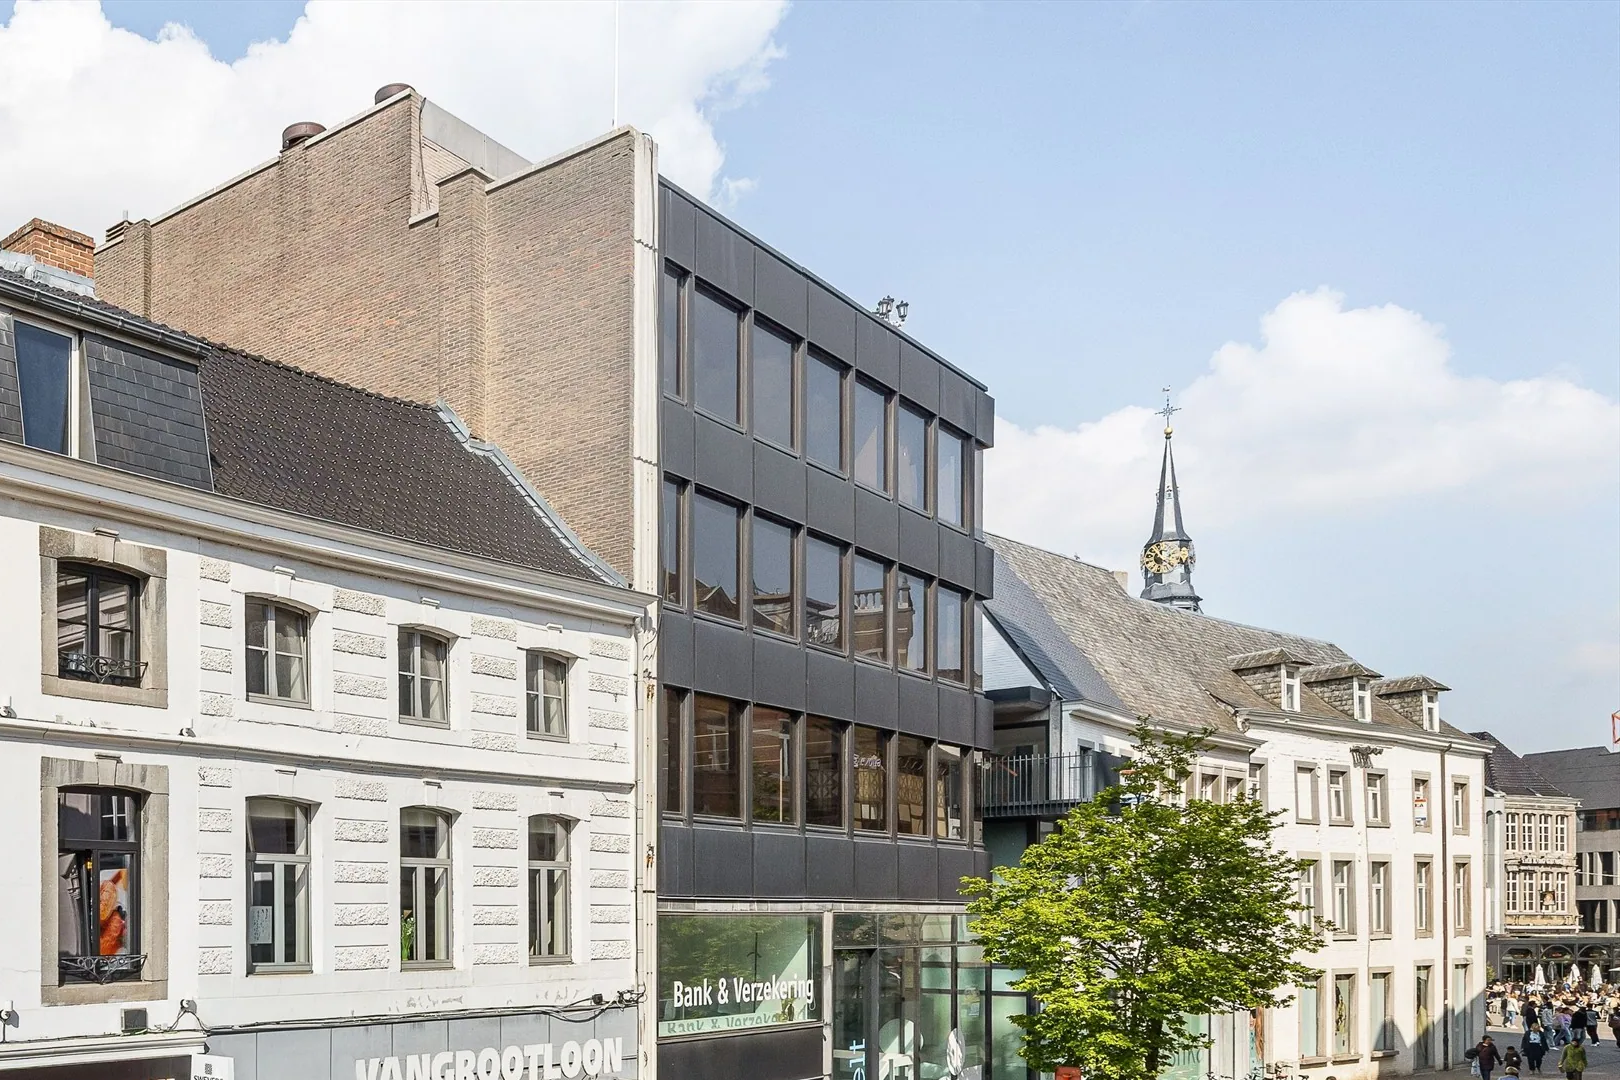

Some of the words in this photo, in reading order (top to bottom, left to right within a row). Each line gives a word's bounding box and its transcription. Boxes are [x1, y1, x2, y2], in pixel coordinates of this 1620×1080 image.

[673, 977, 713, 1008] Bank
[717, 977, 729, 1005] &
[733, 973, 815, 1004] Verzekering
